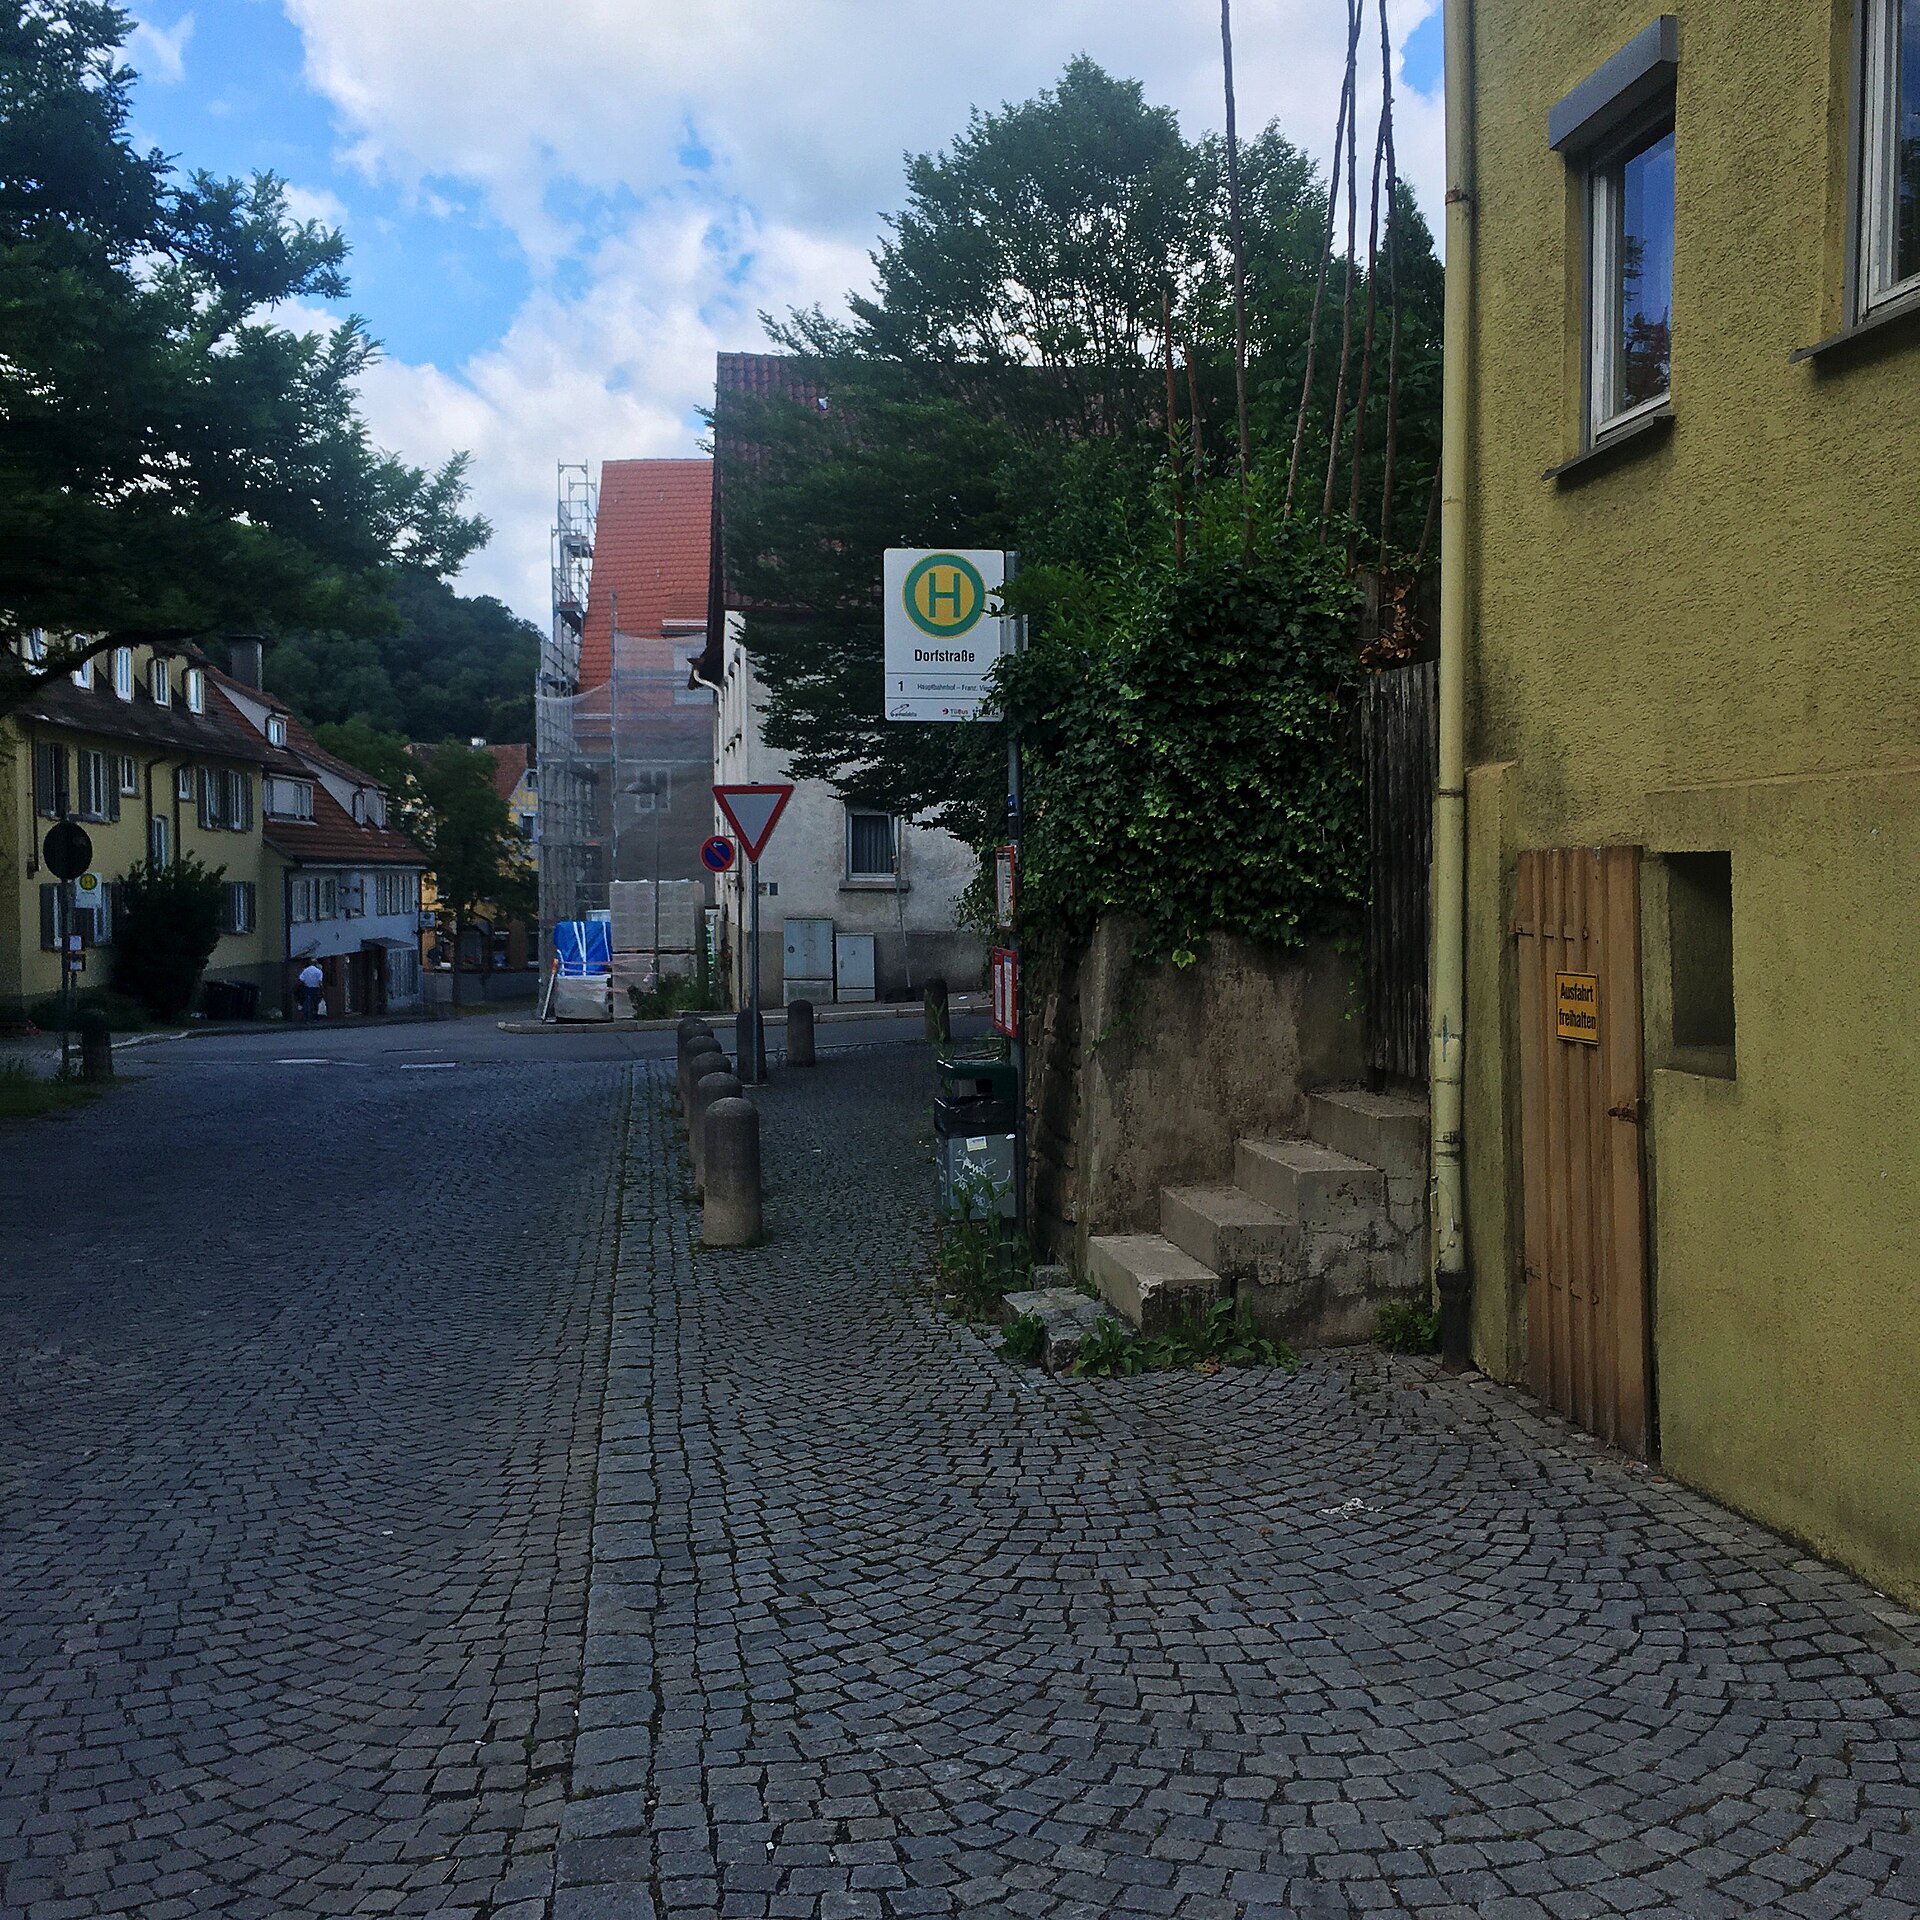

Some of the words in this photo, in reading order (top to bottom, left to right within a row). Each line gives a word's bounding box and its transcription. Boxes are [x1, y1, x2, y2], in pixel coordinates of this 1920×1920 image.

[928, 572, 960, 618] H
[914, 649, 975, 662] Dorfstraße
[897, 680, 904, 692] 1
[1560, 982, 1594, 1002] Ausfahrt
[1558, 1008, 1596, 1029] freihalten
